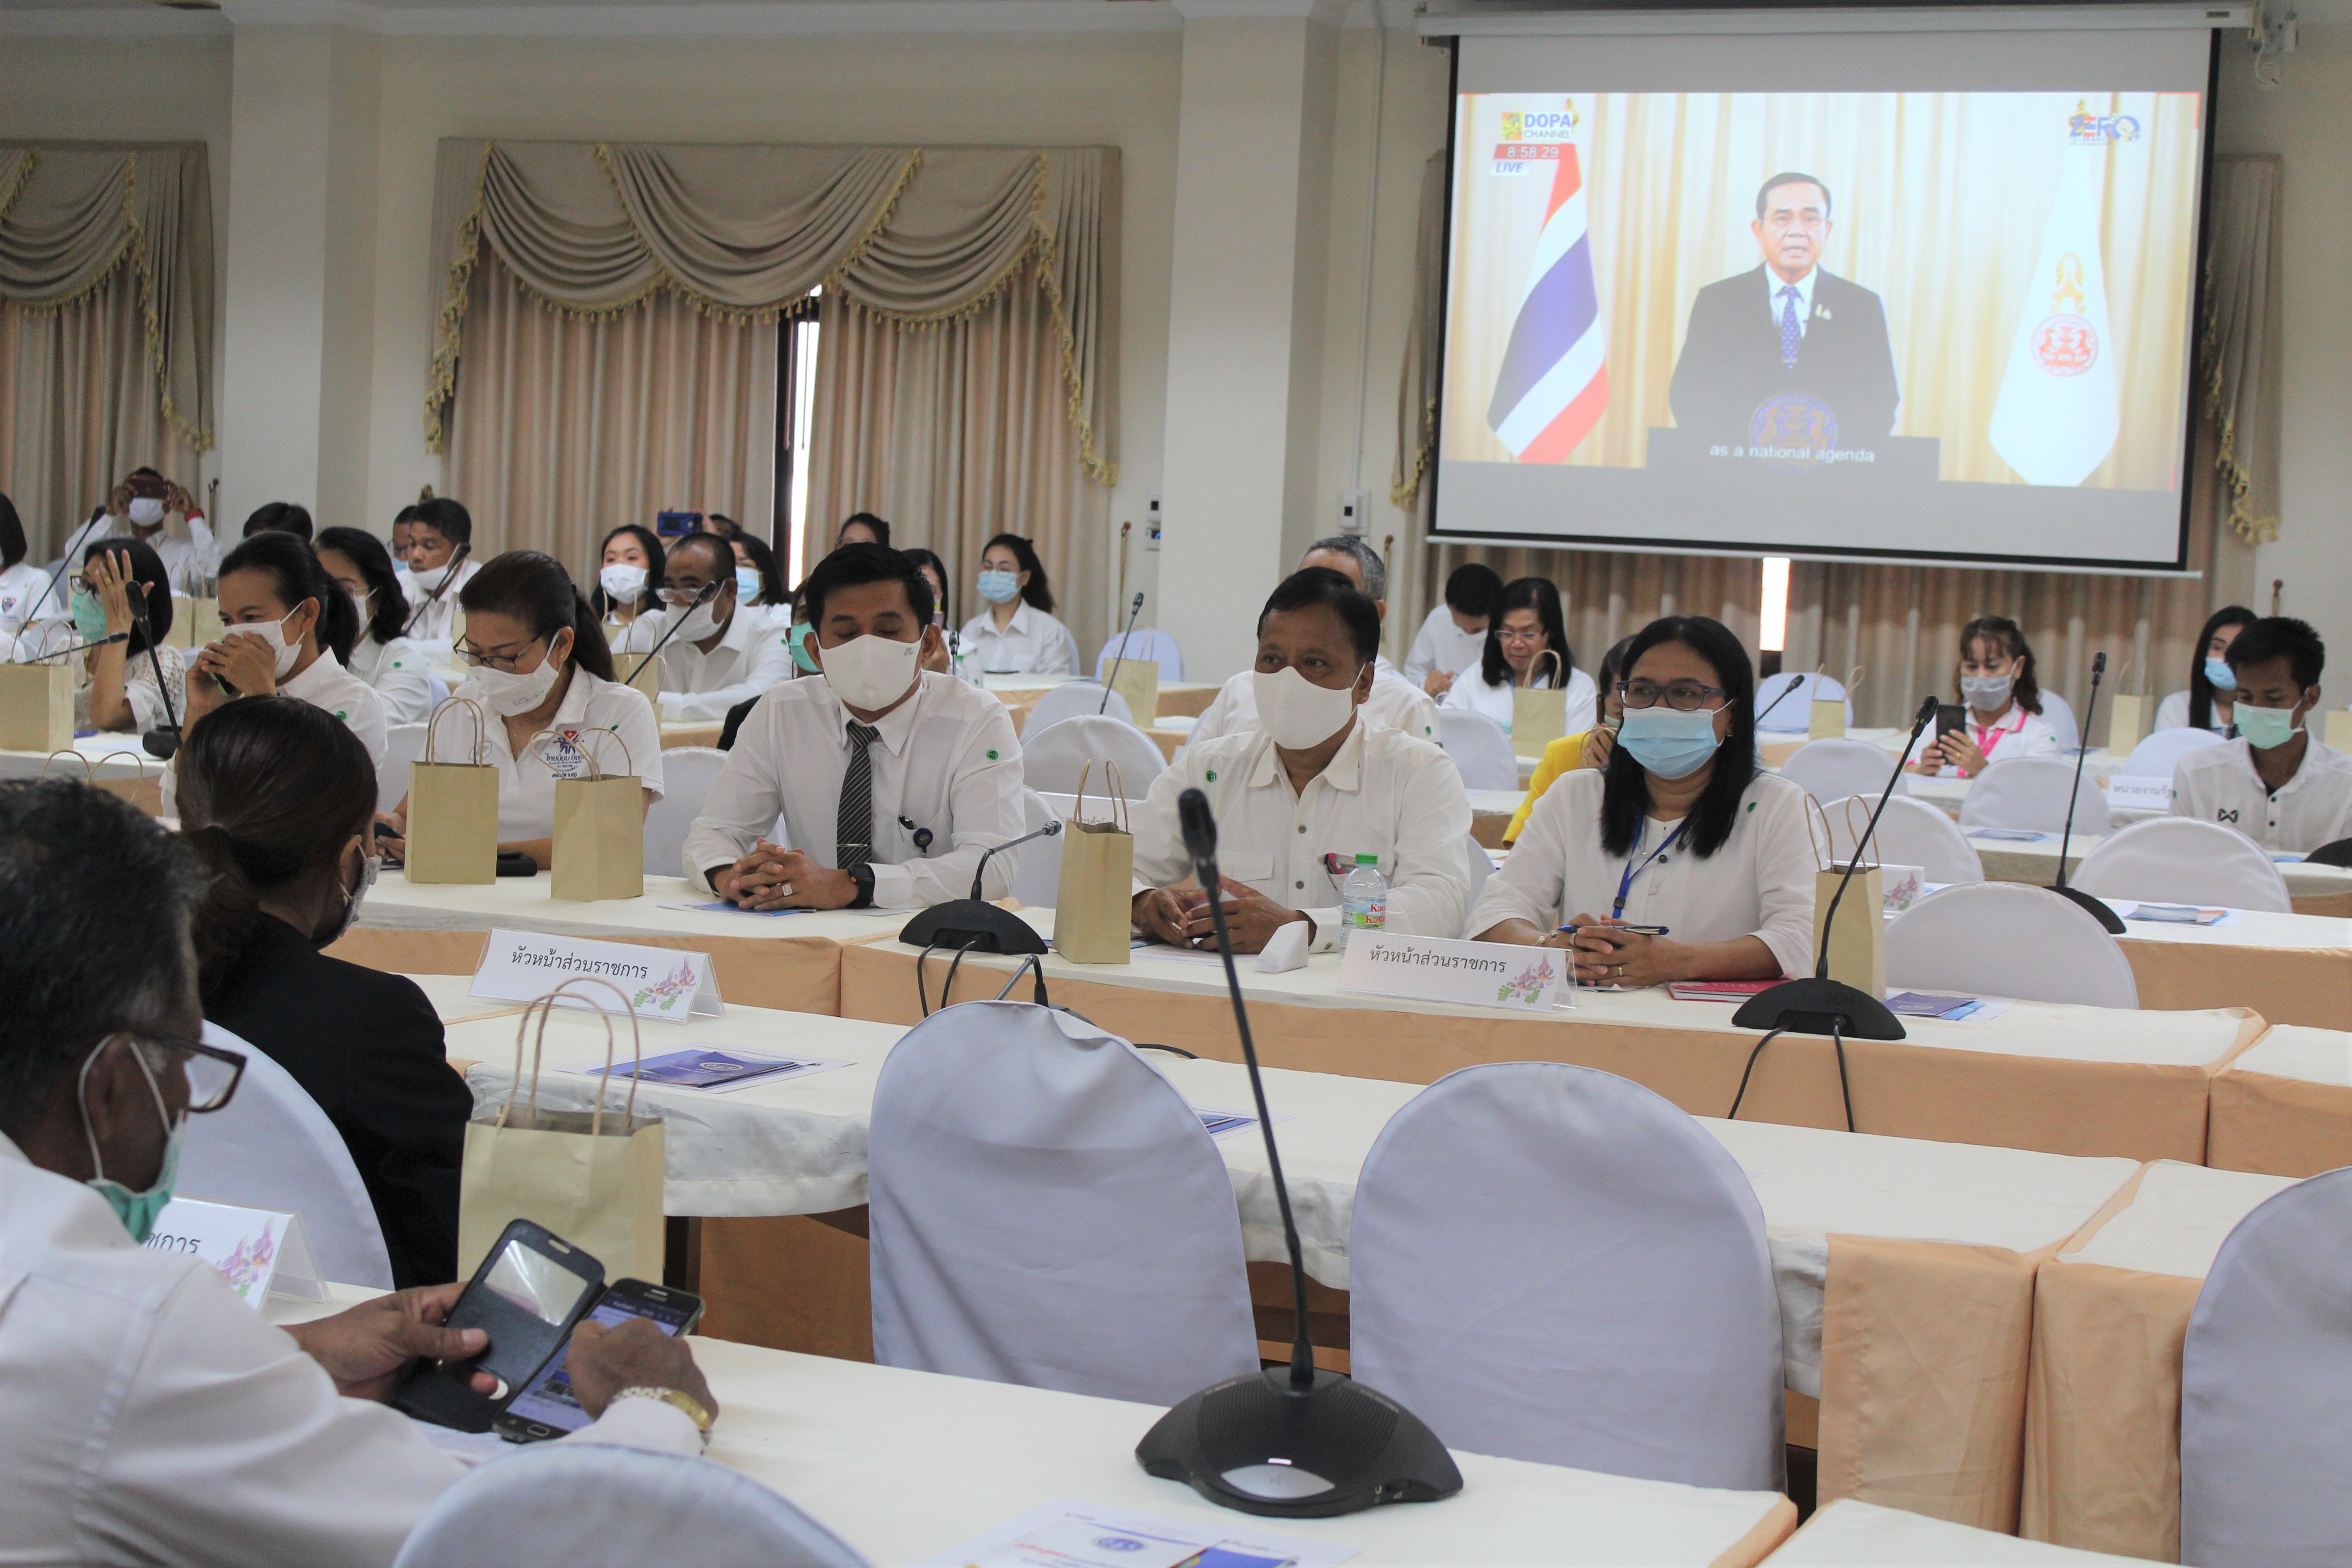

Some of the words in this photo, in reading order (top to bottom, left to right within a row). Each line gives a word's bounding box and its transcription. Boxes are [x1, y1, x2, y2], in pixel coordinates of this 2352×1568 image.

[1524, 113, 1571, 128] DOPA
[1524, 129, 1570, 138] CHANNEL
[1507, 146, 1559, 158] 8:58:29
[1496, 162, 1524, 173] LIVE
[1710, 445, 1728, 457] as
[1733, 446, 1744, 457] a
[1749, 446, 1810, 459] national
[1815, 449, 1875, 464] agenda
[512, 946, 648, 979] หัวหน้าส่วนราชการ
[1370, 945, 1507, 973] หัวหน้าส่วนราชการ
[147, 1232, 201, 1255] ชการ
